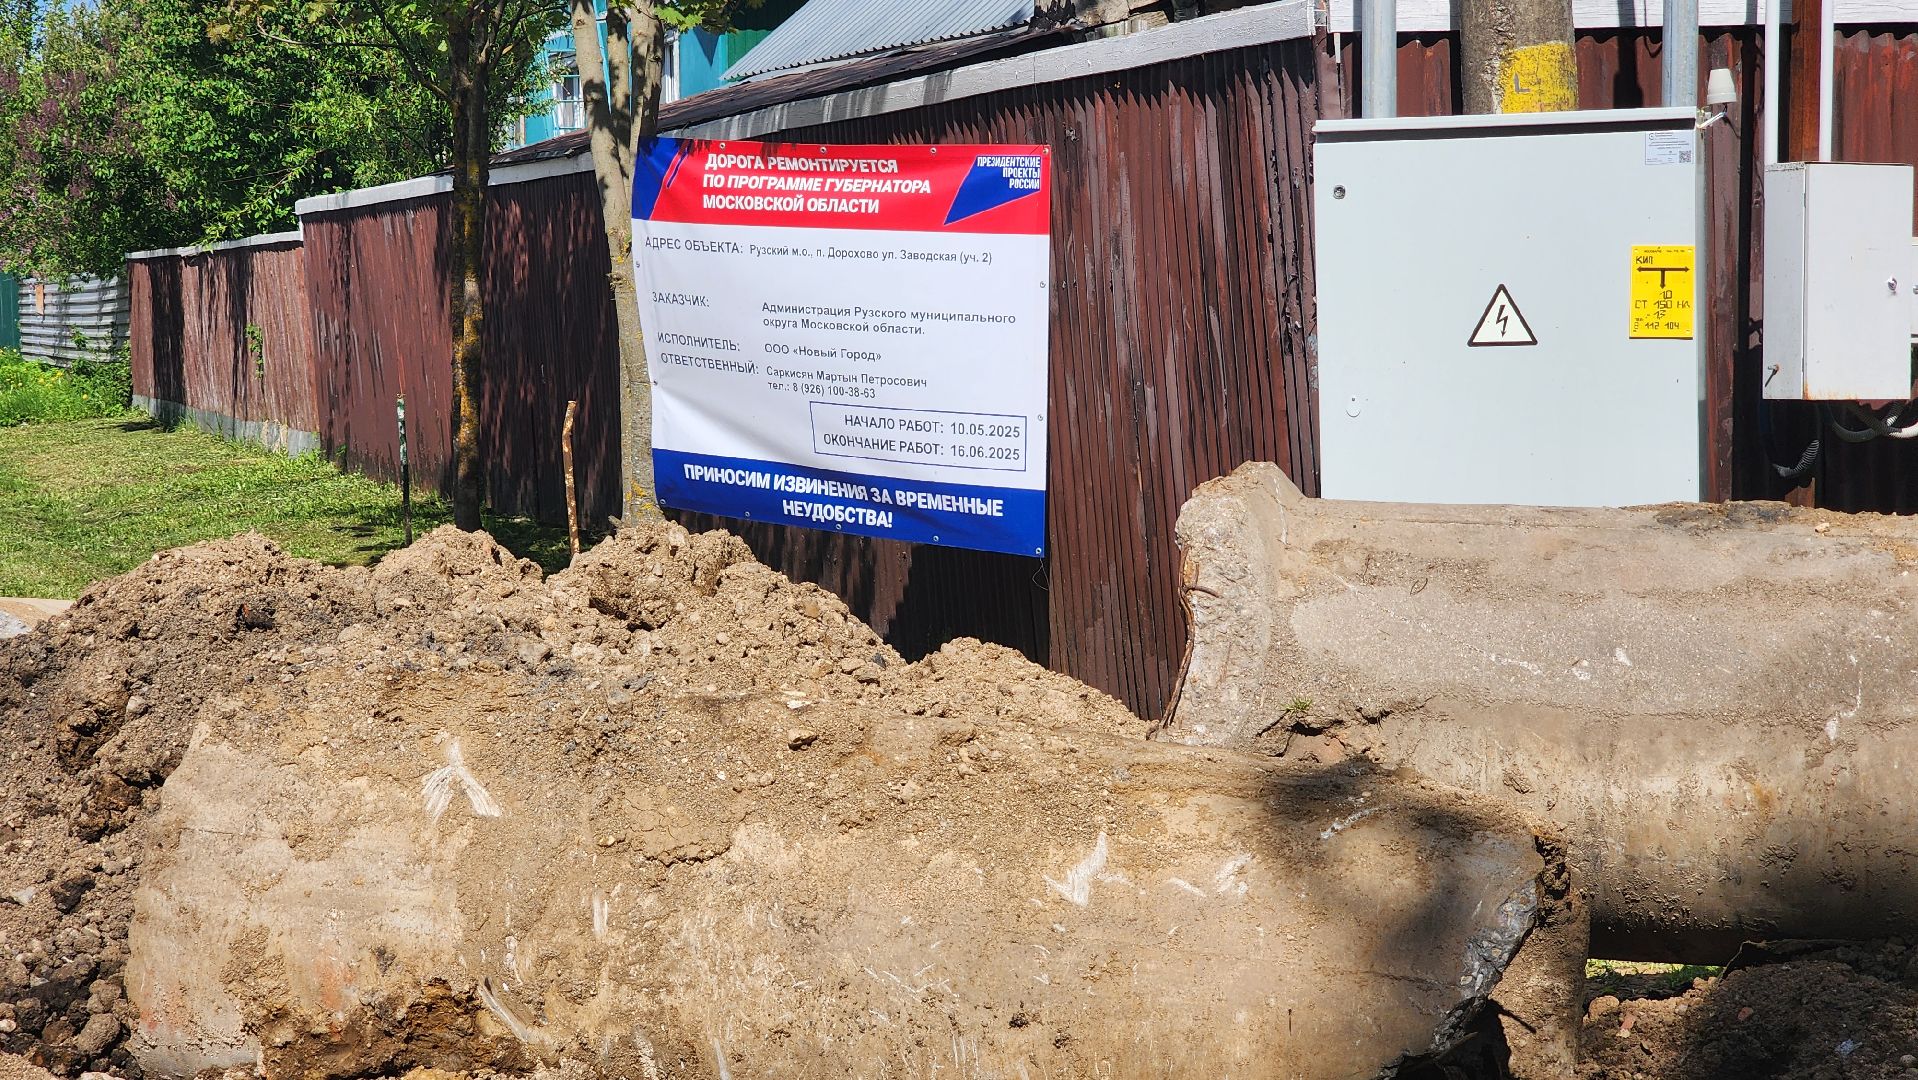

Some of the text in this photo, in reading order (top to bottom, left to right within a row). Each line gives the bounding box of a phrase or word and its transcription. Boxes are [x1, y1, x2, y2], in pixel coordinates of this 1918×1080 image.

[705, 153, 898, 173] ДОРОГА РЕМОНТИРУЕТСЯ
[977, 156, 1041, 168] ПРЕЗИДЕНТСКИЕ
[1002, 167, 1041, 179] ПРОЕКТЫ
[703, 174, 931, 194] ПО ПРОГРАММЕ ГУБЕРНАТОРА
[1009, 178, 1040, 190] РОССИИ
[703, 194, 879, 213] МОСКОВСКОЙ ОБЛАСТИ
[645, 236, 993, 265] АДРЕС ОБЪЕКТА: Рузский м.о., п. Дорохово ул. Заводская (уч. 2)
[652, 291, 710, 308] ЗАКАЗЧИК:
[762, 302, 1016, 324] Администрация Рузского муниципального
[763, 318, 925, 335] округа Московской области.
[657, 331, 741, 352] ИСПОЛНИТЕЛЬ:
[764, 343, 882, 361] ООО «Новый Город»
[660, 352, 760, 375] ОТВЕТСТВЕННЫЙ:
[766, 366, 927, 388] Саркисян Мартын Петросович
[767, 381, 876, 398] тел.: 8 (926) 100-38-63
[845, 414, 1020, 438] НАЧАЛО РАБОТ: 10.05.2025
[823, 433, 1020, 461] ОКОНЧАНИЕ РАБОТ: 16.06.2025
[683, 463, 1003, 517] ПРИНОСИМ ИЗВИНЕНИЯ ЗА ВРЕМЕННЫЕ
[783, 499, 893, 528] НЕУДОБСТВА!
